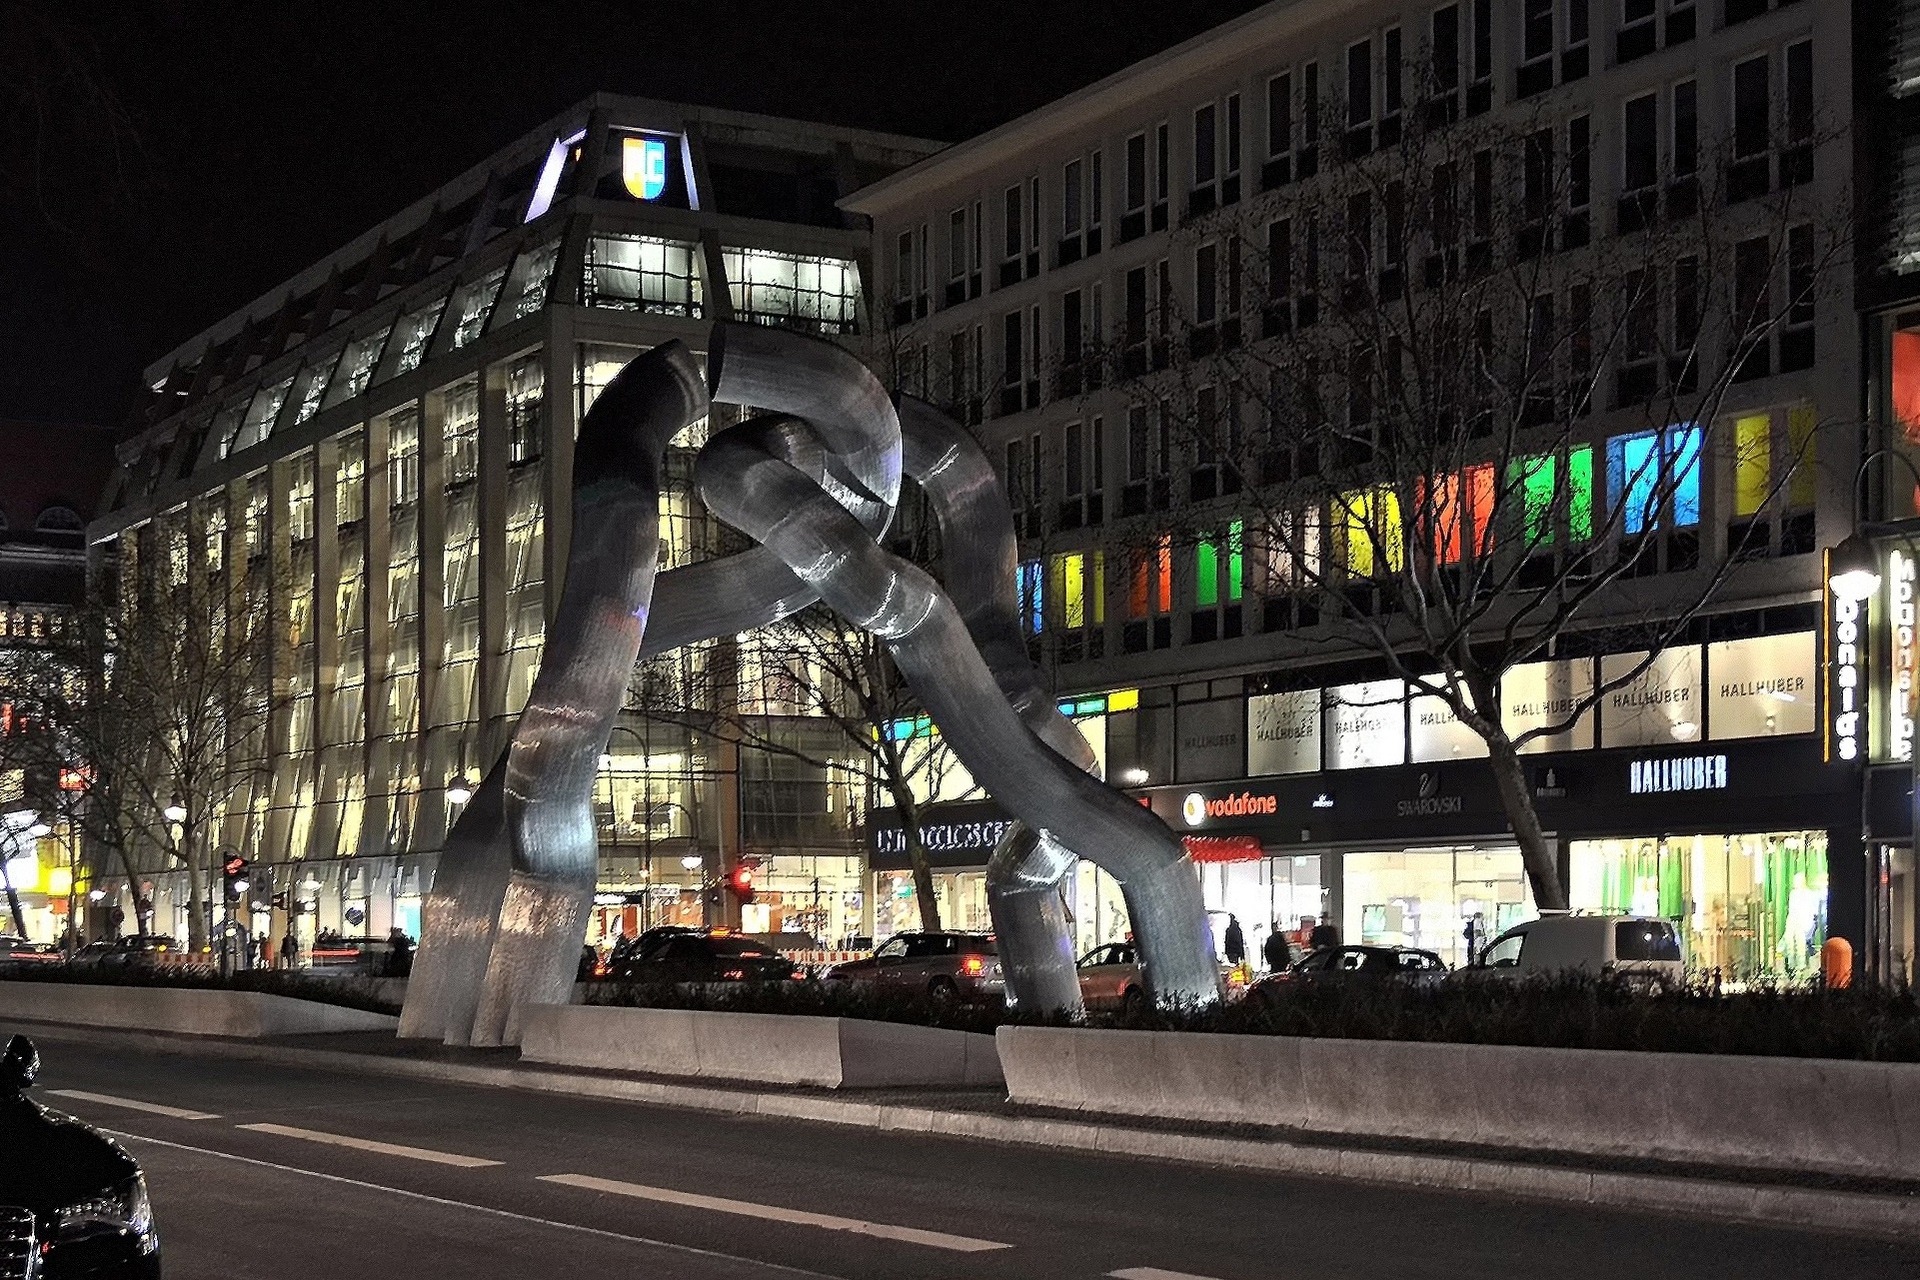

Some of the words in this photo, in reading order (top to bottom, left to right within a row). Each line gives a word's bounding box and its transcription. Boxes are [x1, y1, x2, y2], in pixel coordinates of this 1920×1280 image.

[1720, 676, 1805, 698] HALLHUBER
[1834, 598, 1860, 761] Donalds
[1612, 687, 1690, 708] HALLHUBER
[1420, 711, 1456, 725] HALLH
[1630, 754, 1728, 794] HALLHUBER
[1205, 791, 1278, 818] vodafone
[1396, 795, 1463, 817] SWAROVSKI
